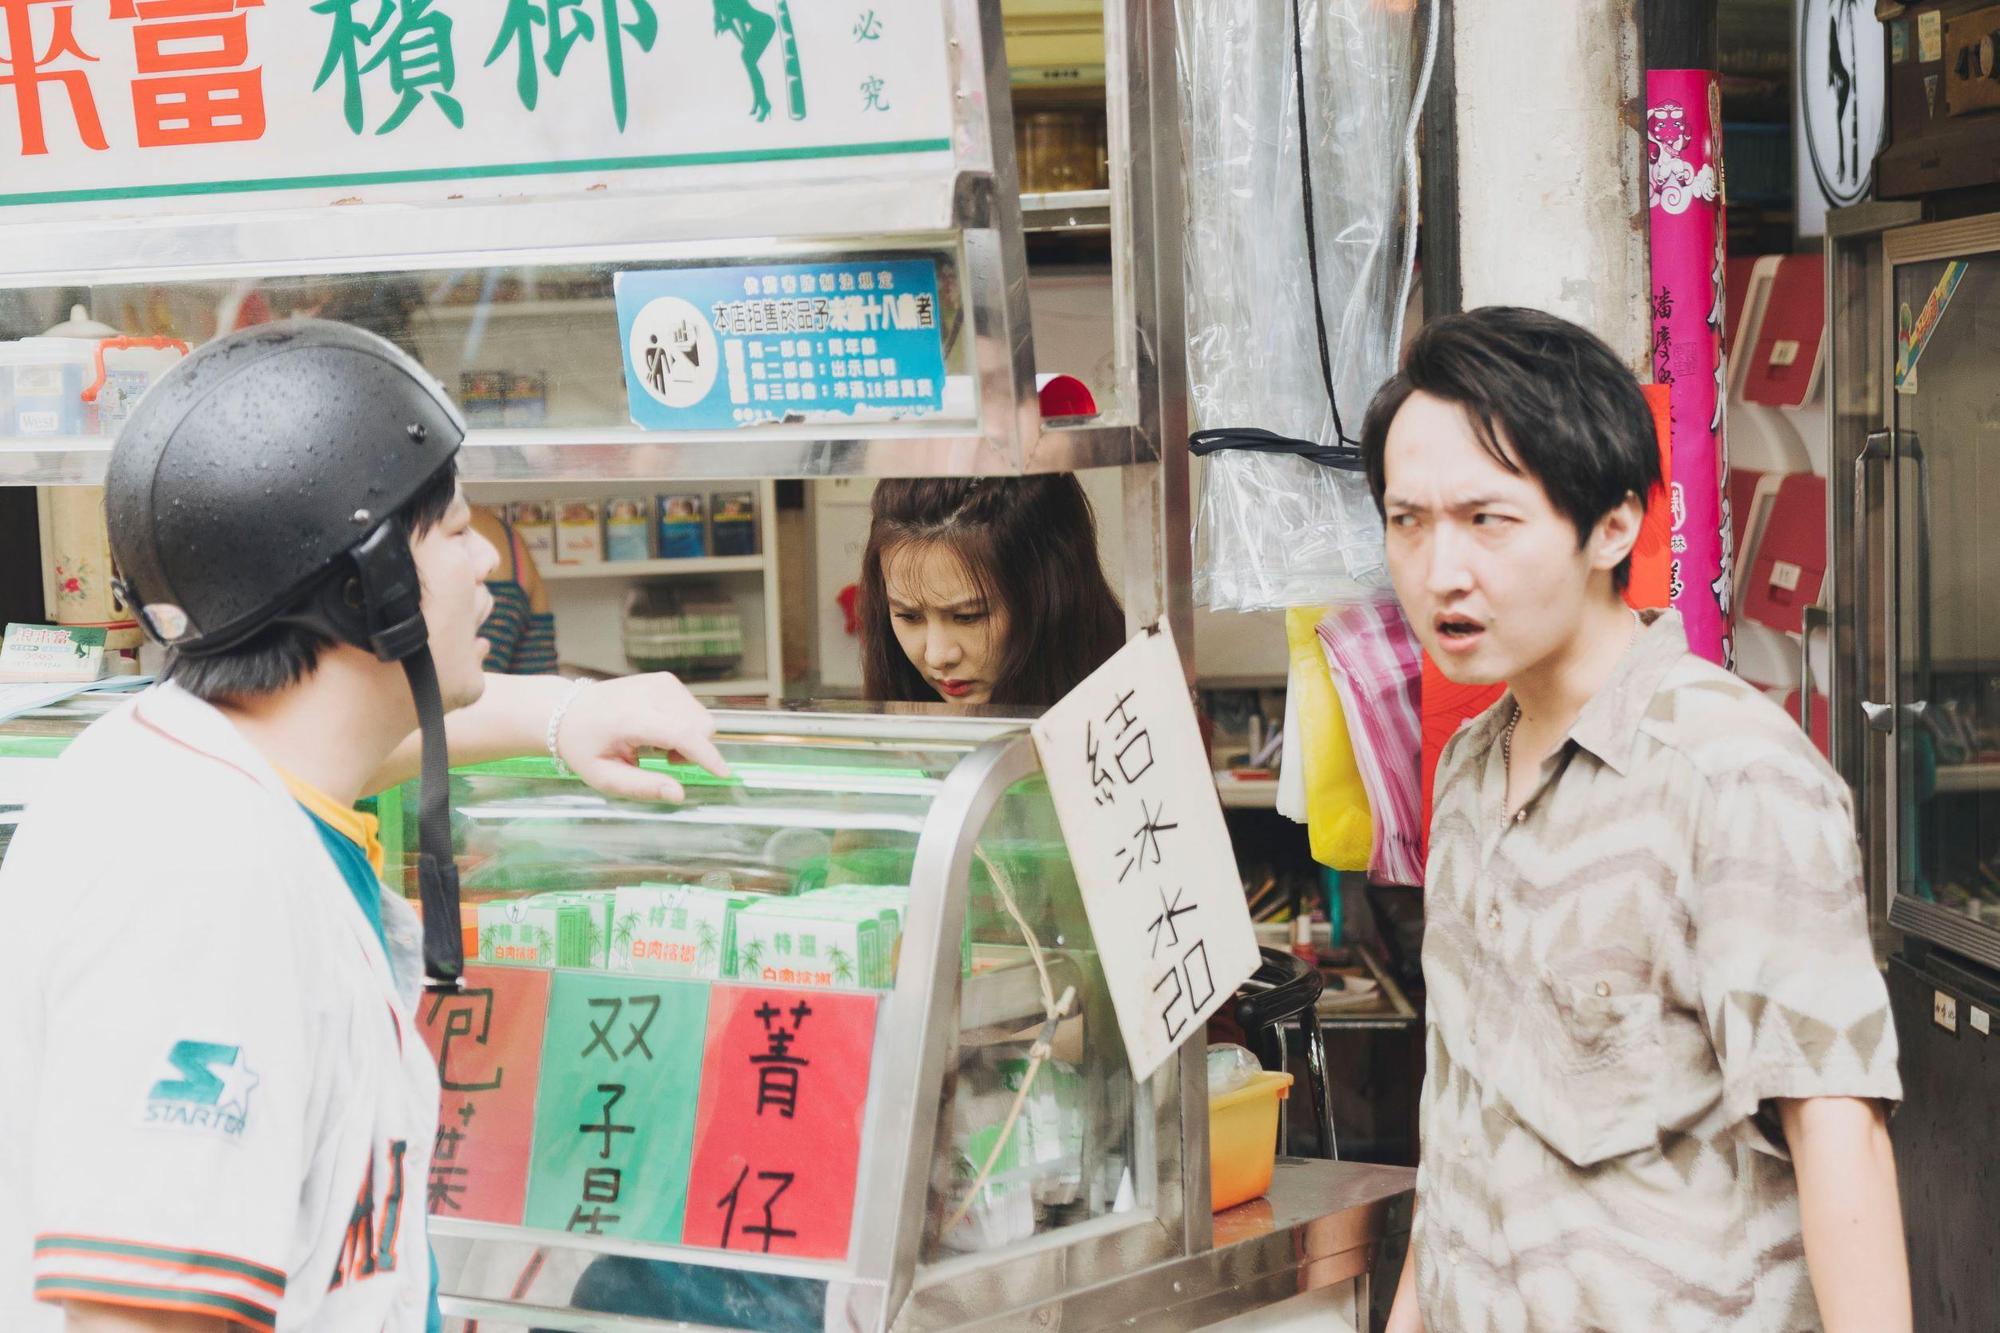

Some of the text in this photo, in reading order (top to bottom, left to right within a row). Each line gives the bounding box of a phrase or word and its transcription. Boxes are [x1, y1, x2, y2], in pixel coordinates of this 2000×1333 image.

[852, 9, 891, 113] 必究
[713, 294, 933, 334] 本店拒售菸品予未十八者
[1086, 688, 1198, 959] 結冰水
[1153, 938, 1215, 1042] 20
[717, 1001, 812, 1253] 菁仔
